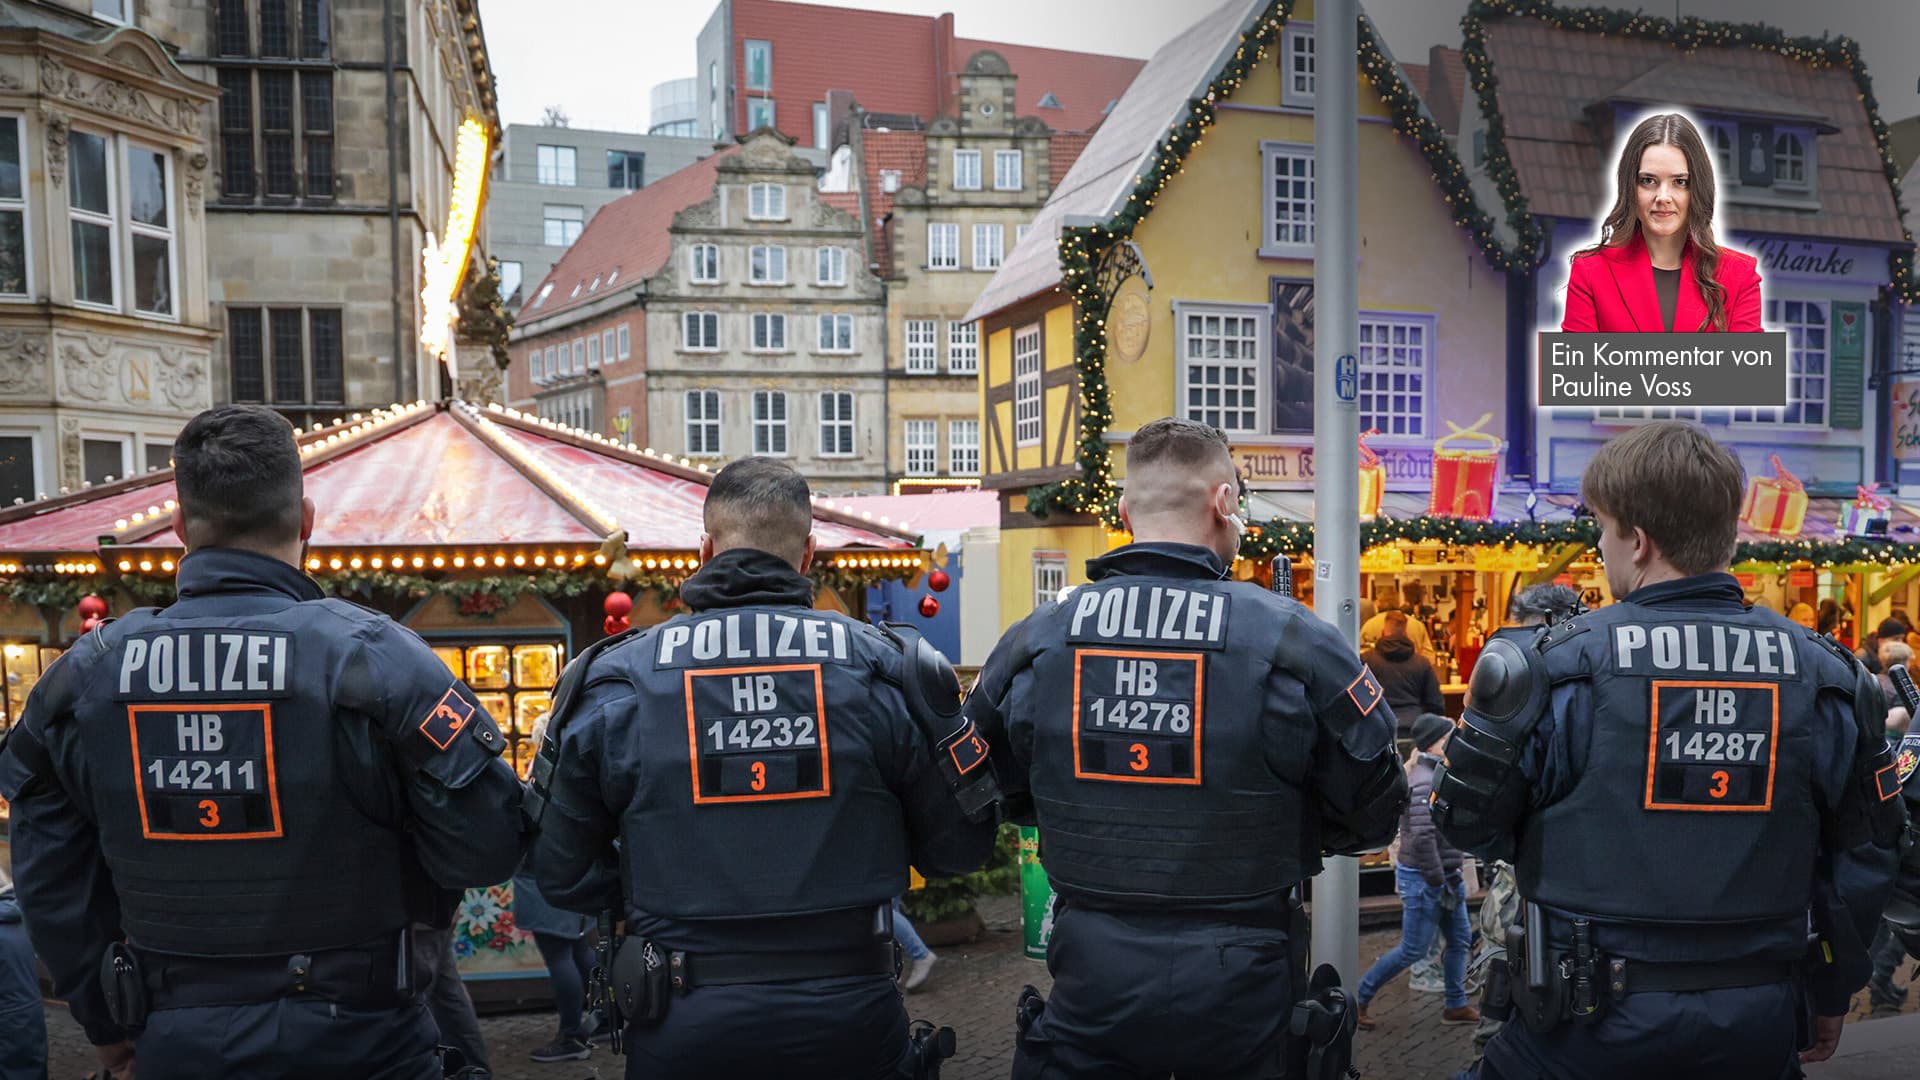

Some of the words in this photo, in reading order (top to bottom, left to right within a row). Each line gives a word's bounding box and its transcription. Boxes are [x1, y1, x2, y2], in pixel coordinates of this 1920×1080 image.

[1243, 454, 1288, 478] zum
[1070, 586, 1224, 641] POLIZEI
[659, 613, 847, 664] POLIZEI
[1616, 625, 1796, 674] POLIZEI
[119, 634, 287, 693] POLIZEI
[1115, 659, 1158, 696] HB
[731, 675, 777, 712] HB
[1364, 679, 1376, 696] 3
[436, 704, 463, 729] 3
[1090, 698, 1190, 733] 14278
[1694, 689, 1737, 725] HB
[176, 714, 224, 751] HB
[707, 716, 816, 750] 14232
[971, 736, 982, 754] 3
[1665, 731, 1765, 761] 14287
[1129, 743, 1150, 771] 3
[148, 759, 255, 790] 14211
[750, 761, 767, 791] 3
[1709, 770, 1730, 798] 3
[198, 800, 221, 828] 3
